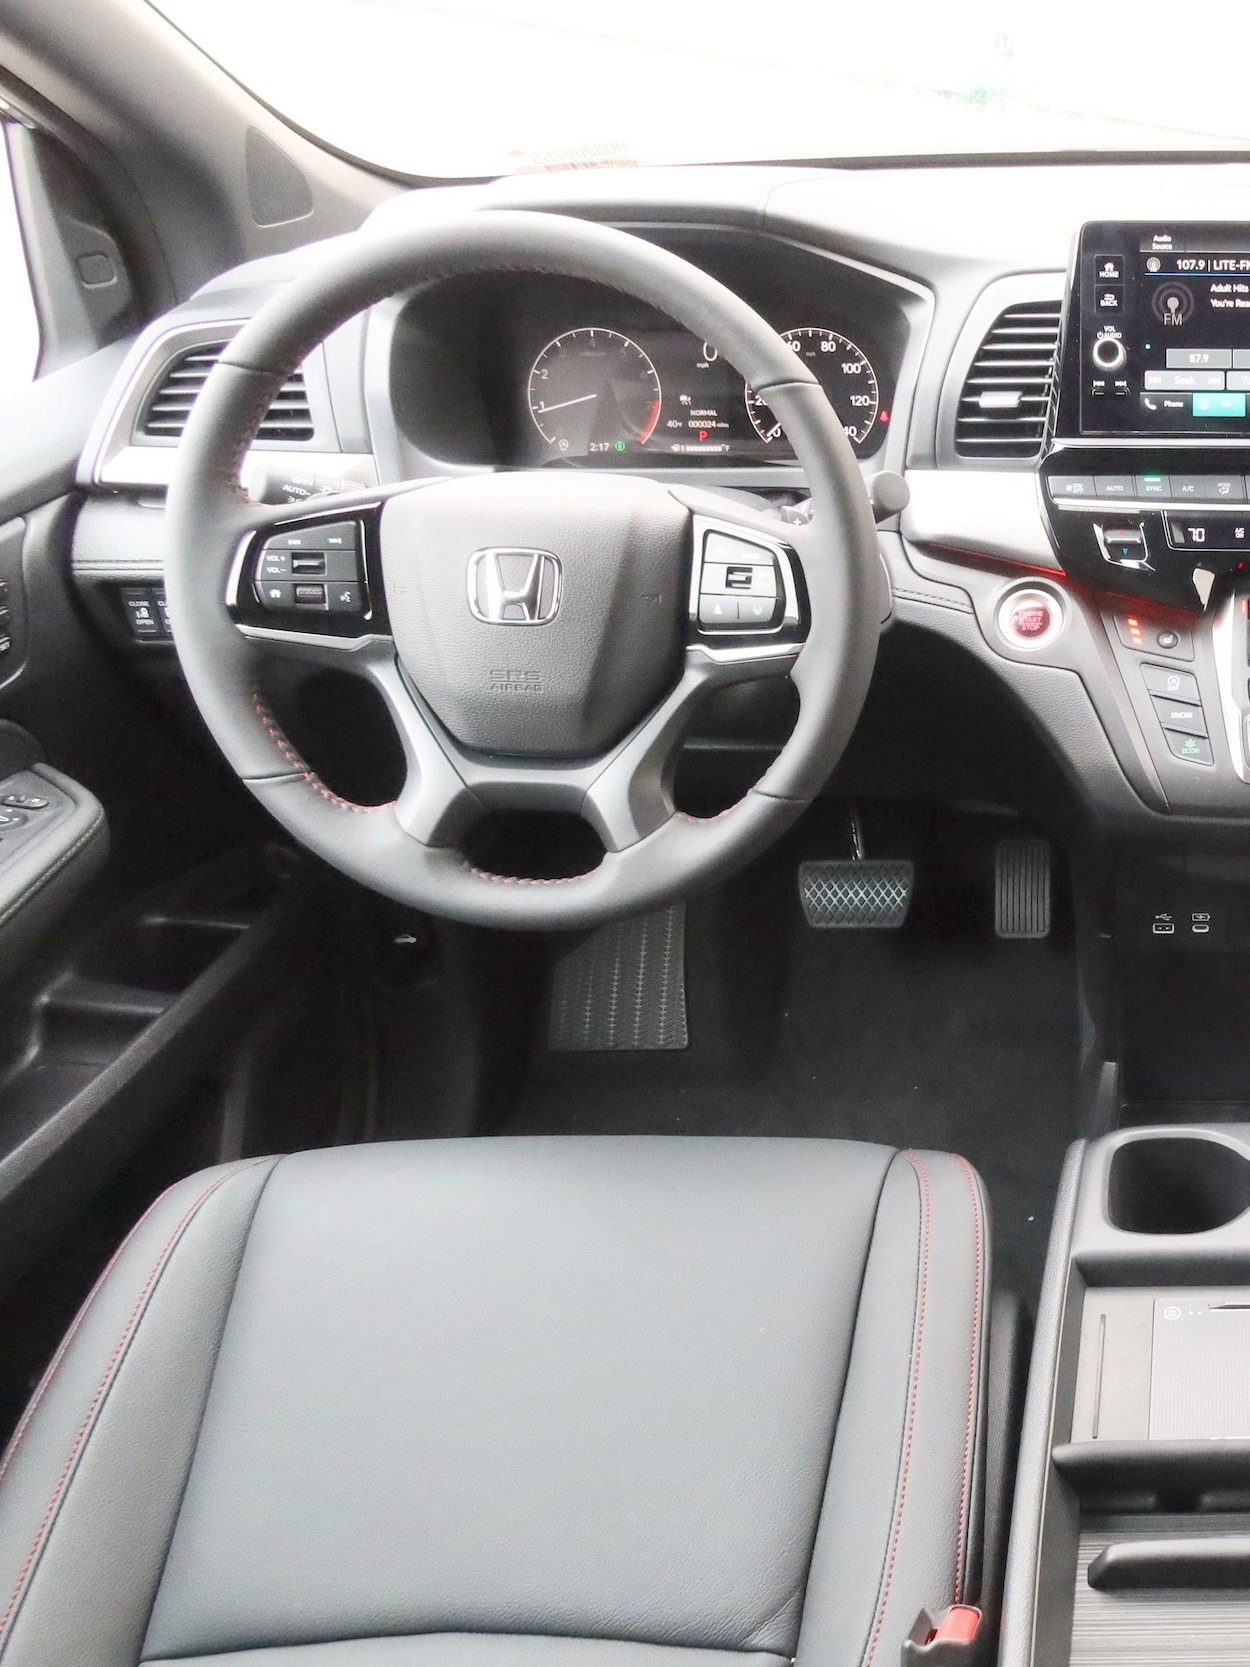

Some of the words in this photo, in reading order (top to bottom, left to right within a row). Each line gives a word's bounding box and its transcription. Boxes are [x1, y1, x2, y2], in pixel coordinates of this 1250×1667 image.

[1176, 260, 1205, 270] 107.9
[1211, 284, 1231, 293] Adult
[1233, 284, 1249, 293] Hits
[1100, 299, 1118, 307] BACK
[1211, 299, 1234, 308] You're
[1164, 313, 1183, 326] FM
[821, 341, 837, 353] 80
[1189, 355, 1209, 363] 87.9
[841, 363, 862, 374] 100
[541, 369, 549, 380] 2
[1174, 376, 1196, 385] Seek
[850, 395, 871, 407] 120
[690, 409, 718, 417] NORMAL
[688, 420, 717, 429] 000024
[699, 430, 709, 442] P
[590, 443, 610, 453] 2:17
[1188, 528, 1206, 543] 70
[490, 670, 543, 683] SRS
[490, 683, 543, 692] AIRBAG
